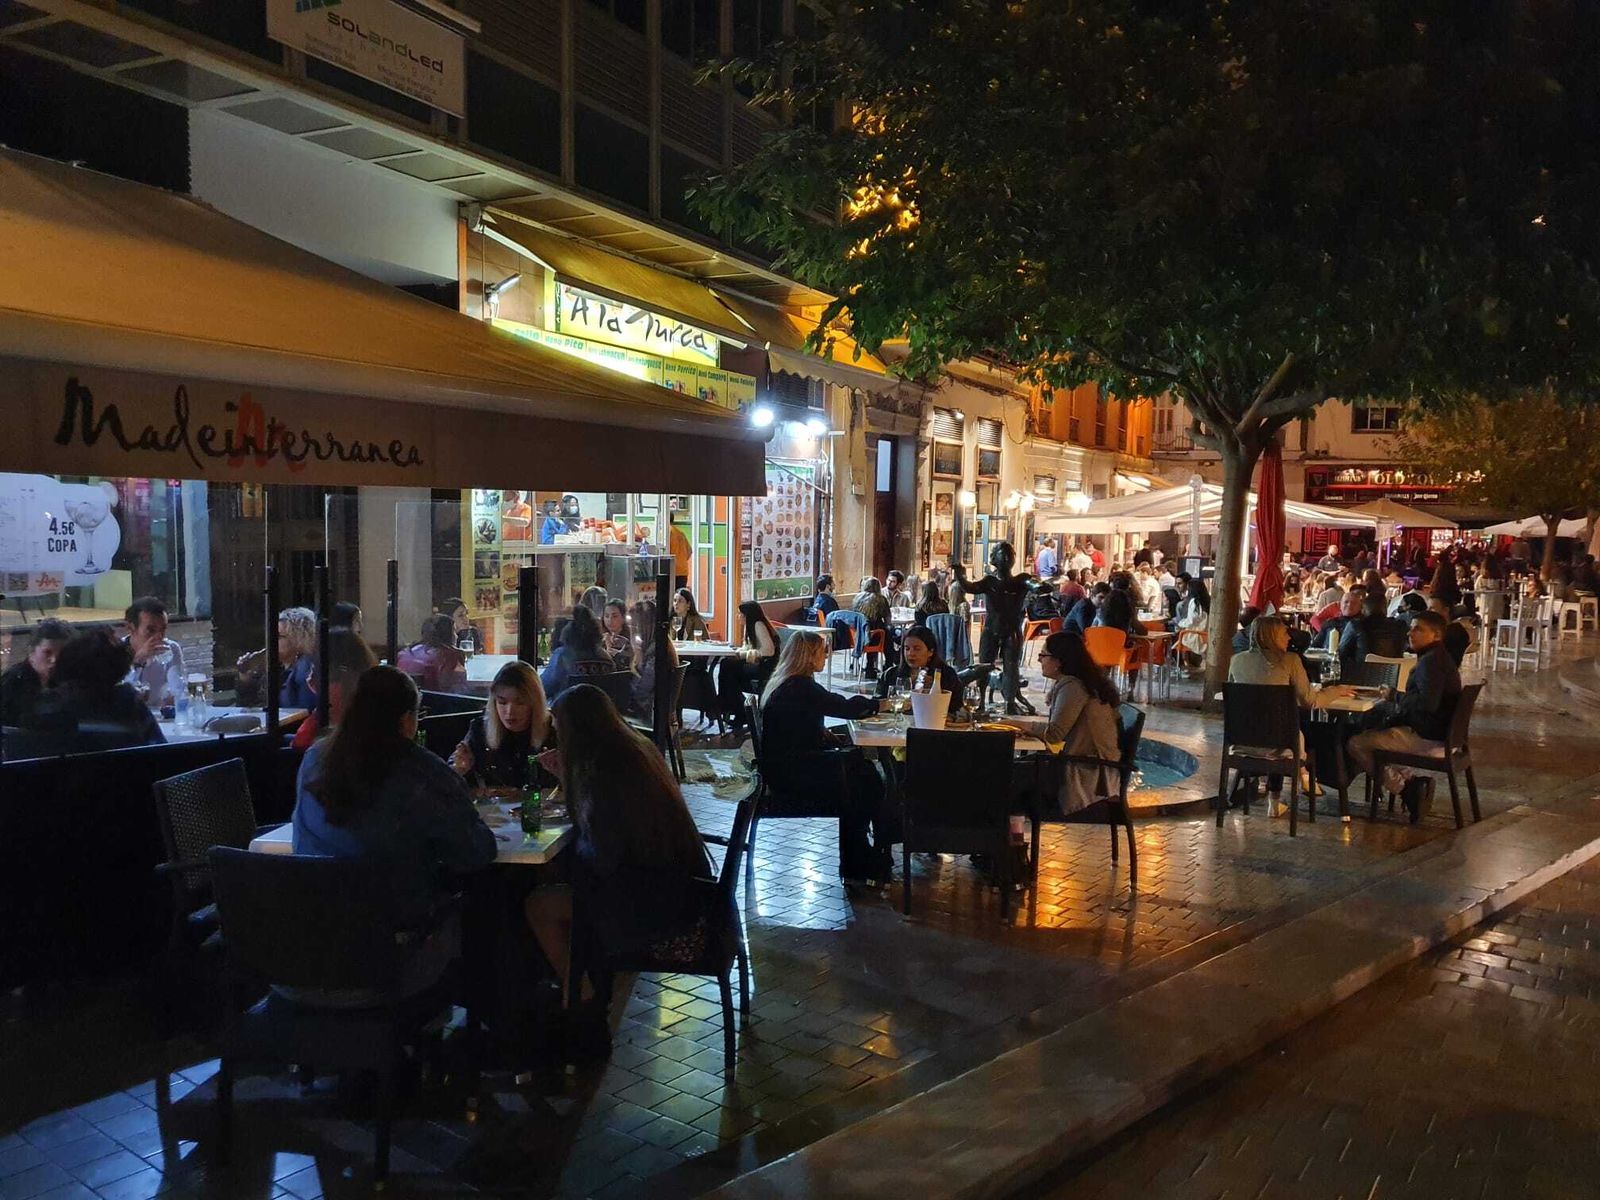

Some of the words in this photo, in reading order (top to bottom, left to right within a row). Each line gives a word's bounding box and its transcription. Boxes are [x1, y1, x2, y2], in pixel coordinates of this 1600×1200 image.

[570, 295, 589, 325] A
[599, 304, 622, 334] la
[625, 309, 707, 350] Turca
